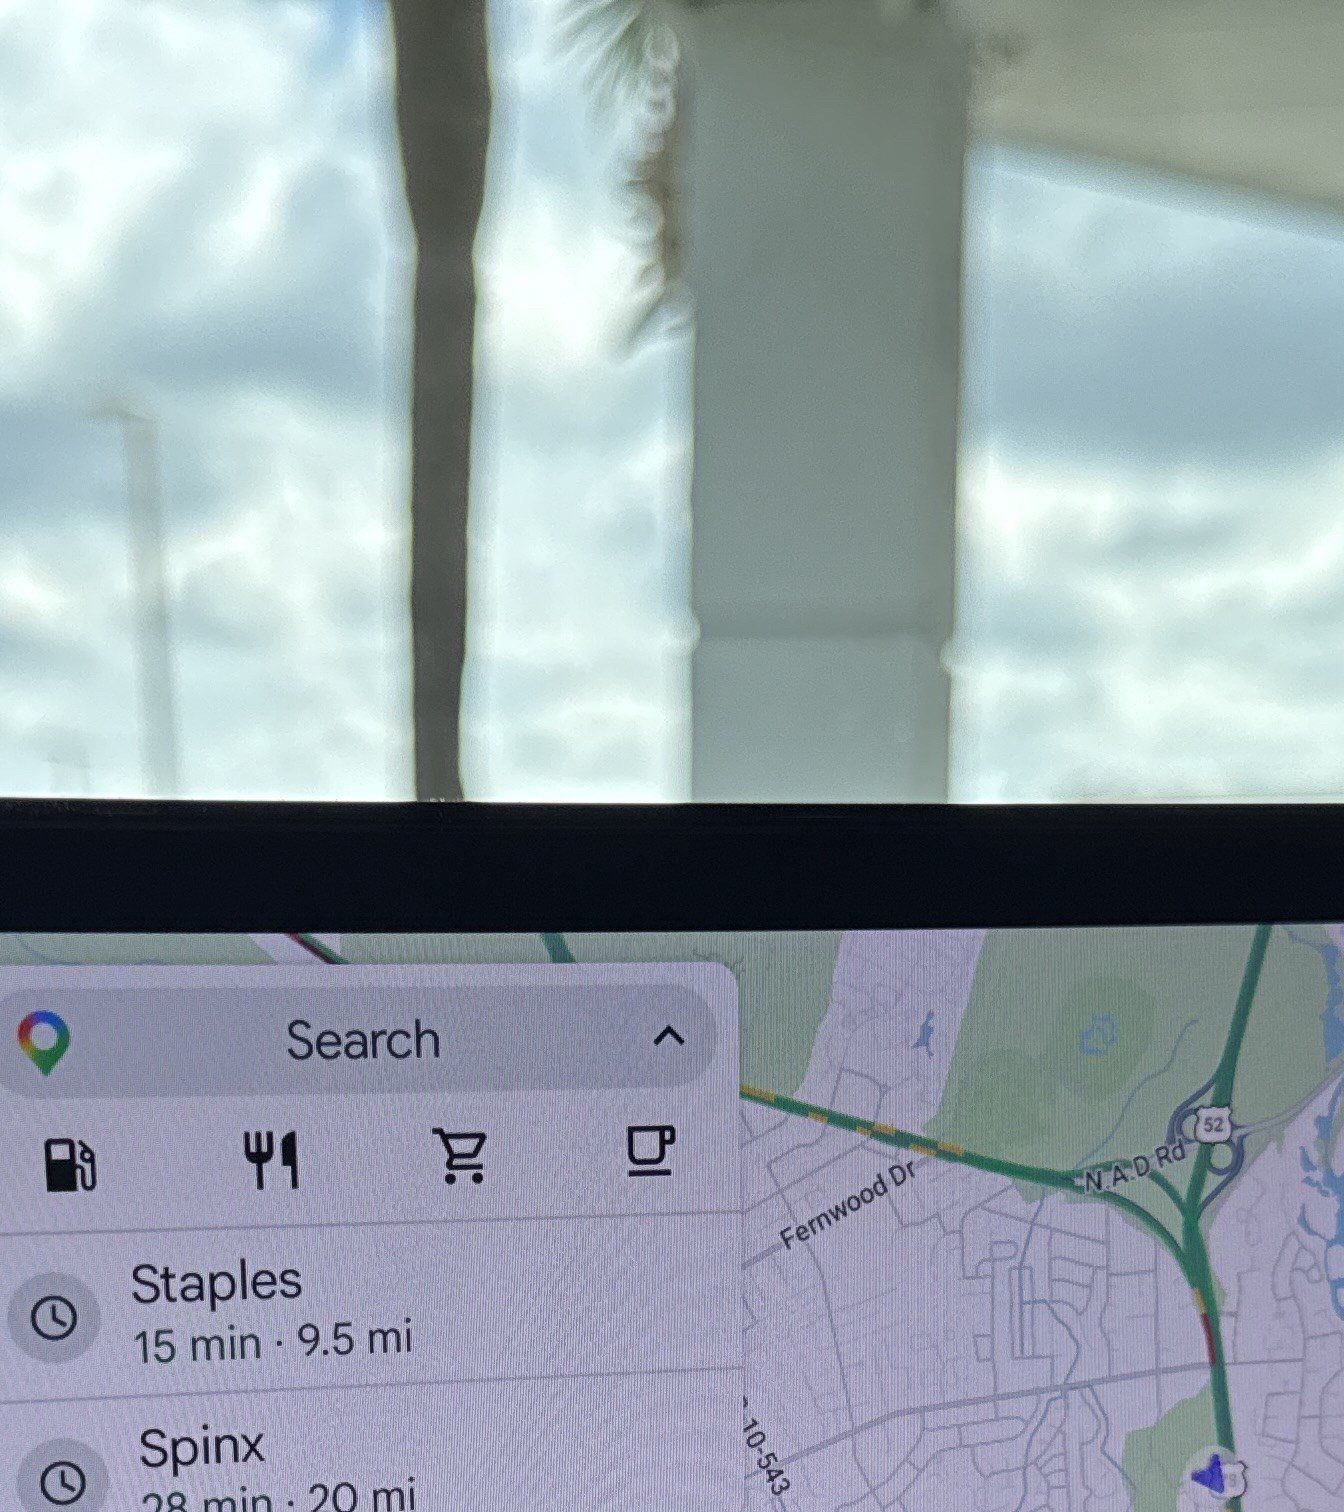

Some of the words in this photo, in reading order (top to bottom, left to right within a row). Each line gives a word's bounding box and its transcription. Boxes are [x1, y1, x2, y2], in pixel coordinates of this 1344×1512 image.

[287, 1018, 441, 1061] Search
[1204, 1117, 1224, 1132] 52
[1155, 1139, 1186, 1168] Rd
[779, 1172, 889, 1249] Fernwood
[889, 1161, 918, 1190] Dr
[132, 1259, 302, 1312] Staples
[135, 1330, 176, 1364] 15
[191, 1326, 262, 1360] min
[298, 1322, 354, 1358] 9.5
[369, 1318, 413, 1354] mi
[141, 1425, 264, 1478] Spinx
